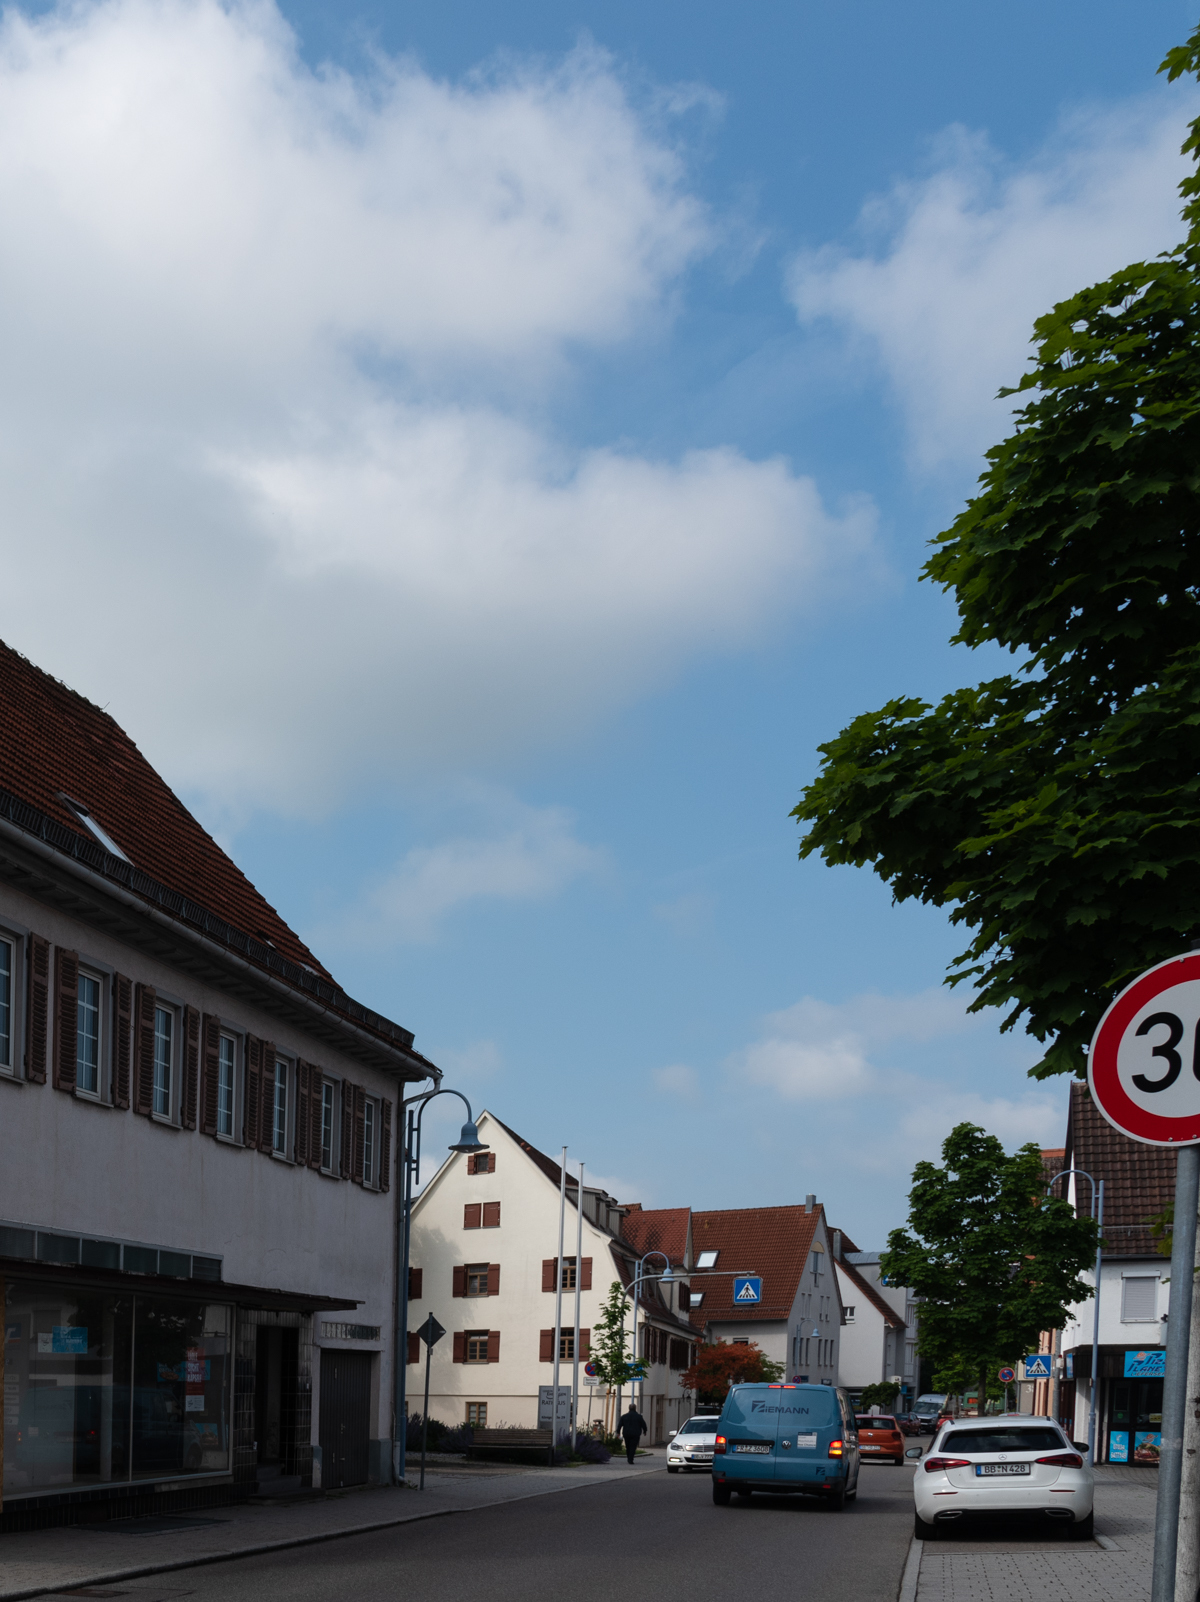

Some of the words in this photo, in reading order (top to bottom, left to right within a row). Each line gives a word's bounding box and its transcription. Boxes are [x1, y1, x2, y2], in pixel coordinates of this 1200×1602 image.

[1131, 1011, 1200, 1093] 3
[984, 1465, 996, 1473] BB
[1001, 1465, 1008, 1473] N
[1009, 1464, 1026, 1473] 428
